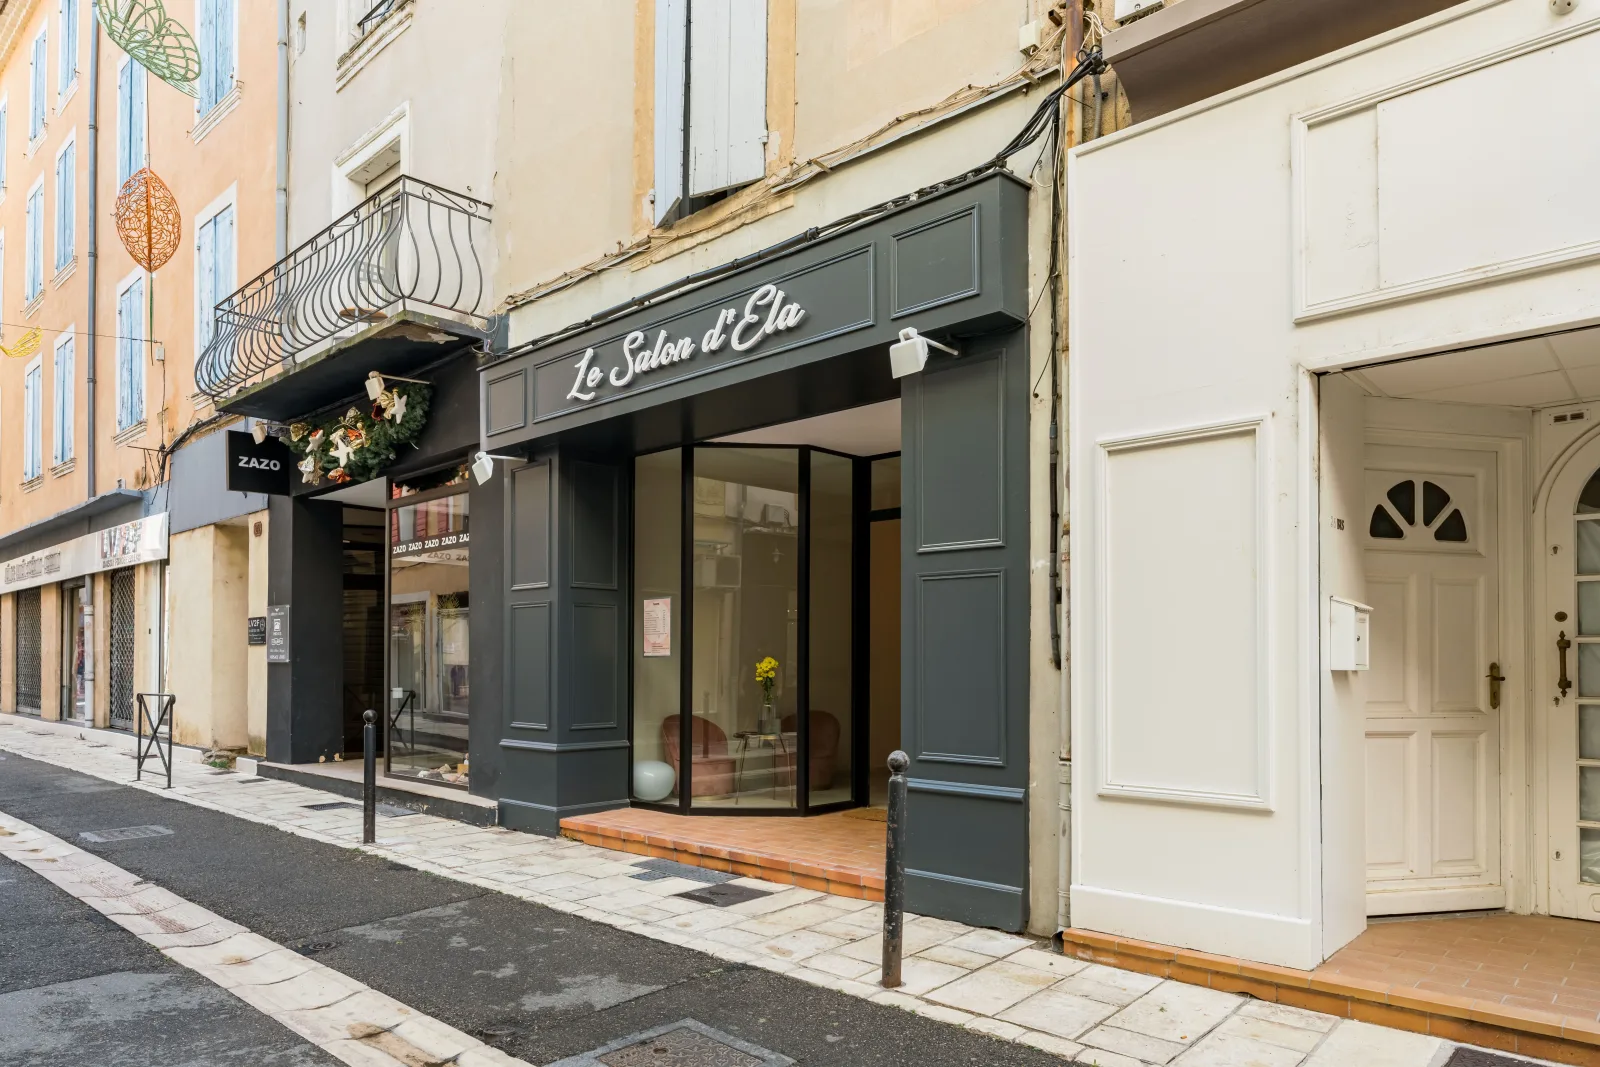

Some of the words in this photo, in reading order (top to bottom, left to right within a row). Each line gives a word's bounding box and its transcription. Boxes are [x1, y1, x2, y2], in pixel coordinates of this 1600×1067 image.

[566, 348, 604, 400] Le
[609, 329, 696, 387] Salon
[701, 284, 806, 353] d'Ela
[238, 455, 281, 471] ZAZO
[392, 544, 407, 554] ZAZO
[408, 541, 423, 551] ZAZO
[424, 538, 440, 549] ZAZO
[441, 535, 457, 546] ZAZO
